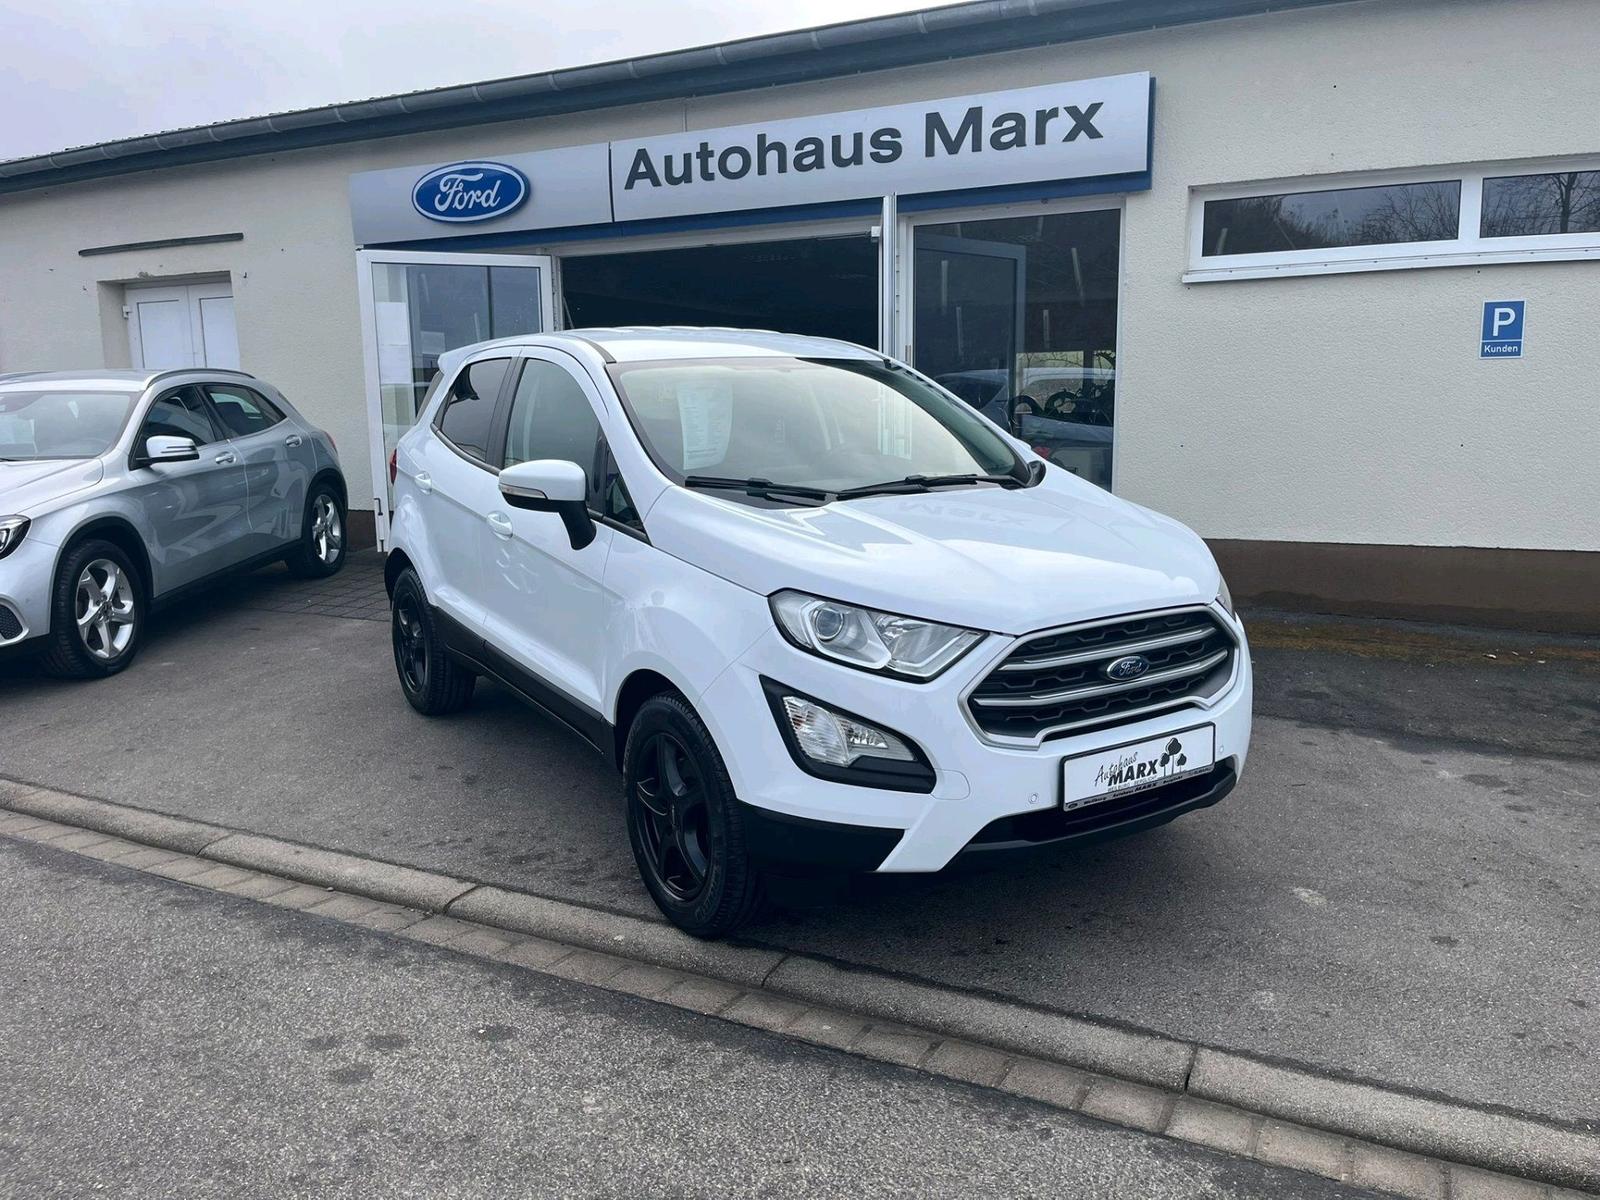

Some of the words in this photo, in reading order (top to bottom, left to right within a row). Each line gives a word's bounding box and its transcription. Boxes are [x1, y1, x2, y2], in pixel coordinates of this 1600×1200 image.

[624, 127, 903, 190] Autohaus
[925, 101, 1104, 158] Marx
[434, 173, 501, 212] Ford
[1492, 308, 1515, 336] P
[1484, 345, 1518, 353] Kunden
[1094, 751, 1138, 787] Autohaus
[1108, 758, 1159, 787] MARX
